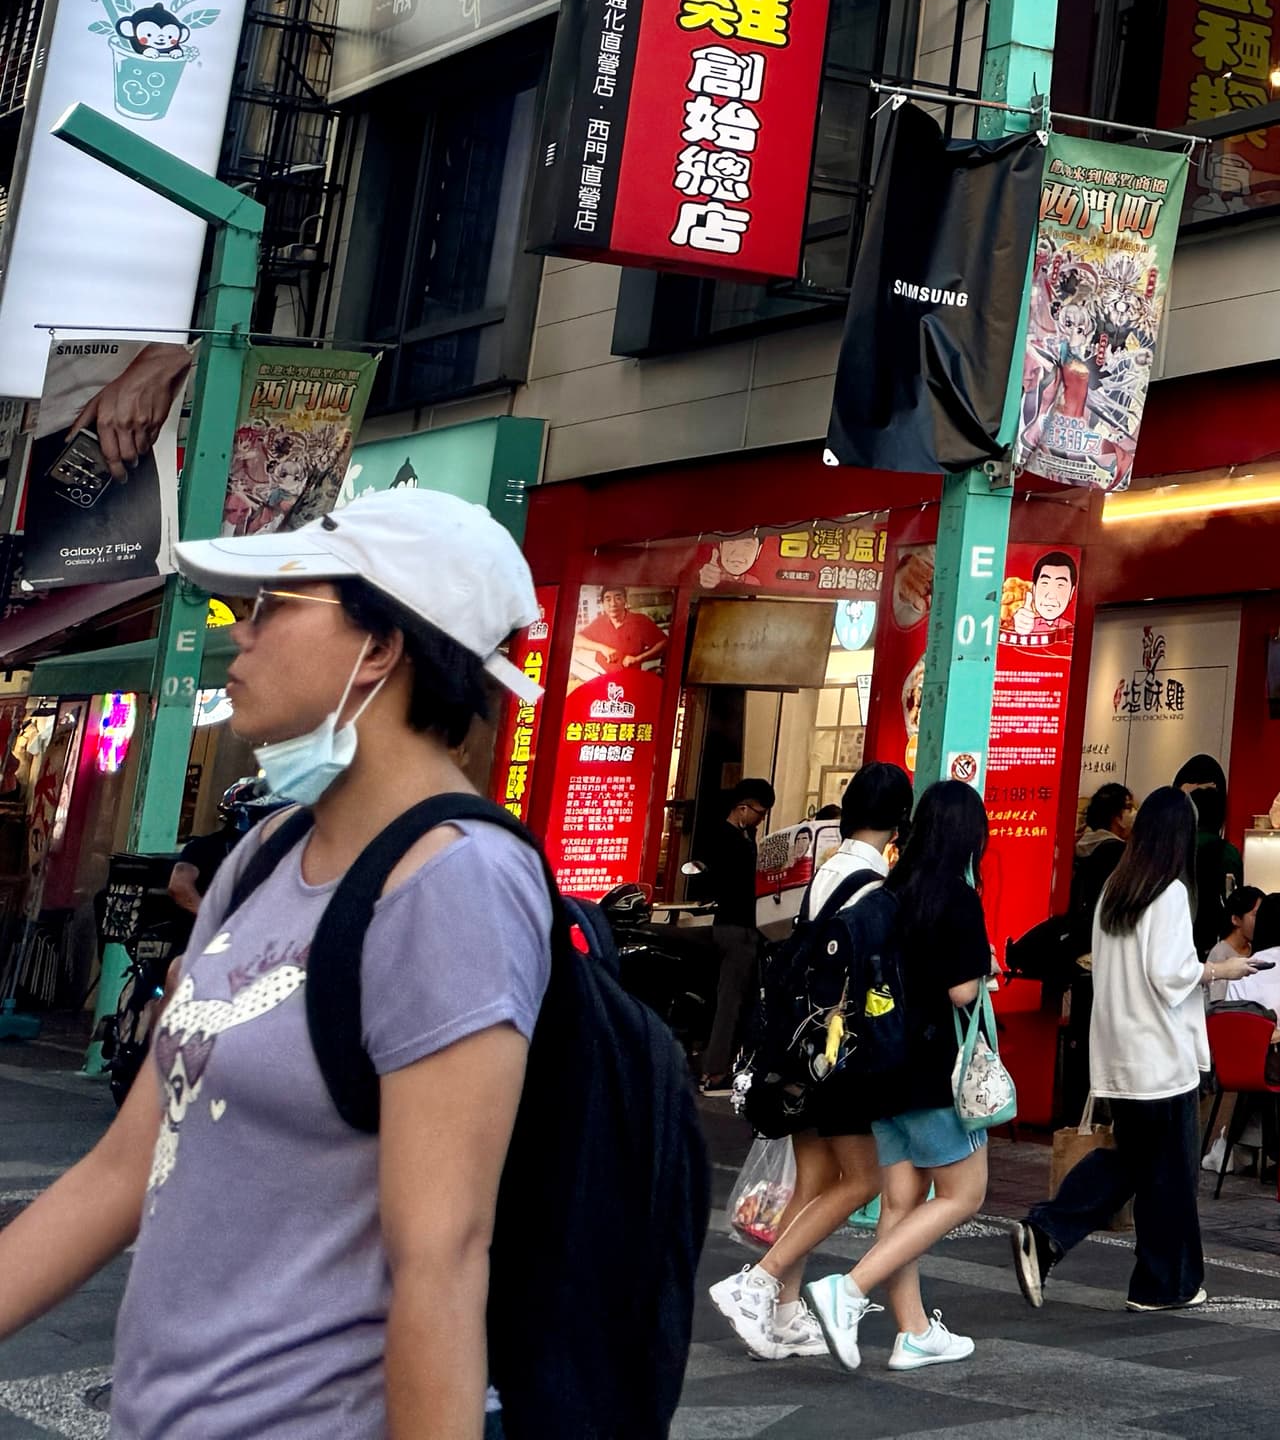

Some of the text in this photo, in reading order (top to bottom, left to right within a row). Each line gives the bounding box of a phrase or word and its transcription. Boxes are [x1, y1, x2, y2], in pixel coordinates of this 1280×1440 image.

[670, 46, 766, 255] 創始總店
[574, 118, 611, 232] 西門直營店
[1040, 181, 1164, 239] 西門町
[894, 280, 968, 307] SAMSUNG
[56, 344, 119, 355] SAMSUNG
[250, 379, 358, 412] 西門町
[60, 546, 103, 559] Galaxy
[106, 545, 113, 554] Z
[115, 541, 142, 554] Flip6
[970, 546, 995, 577] E
[176, 631, 196, 651] E
[957, 615, 994, 645] 01
[165, 677, 195, 696] 03
[1122, 679, 1185, 713] 塩酥雞
